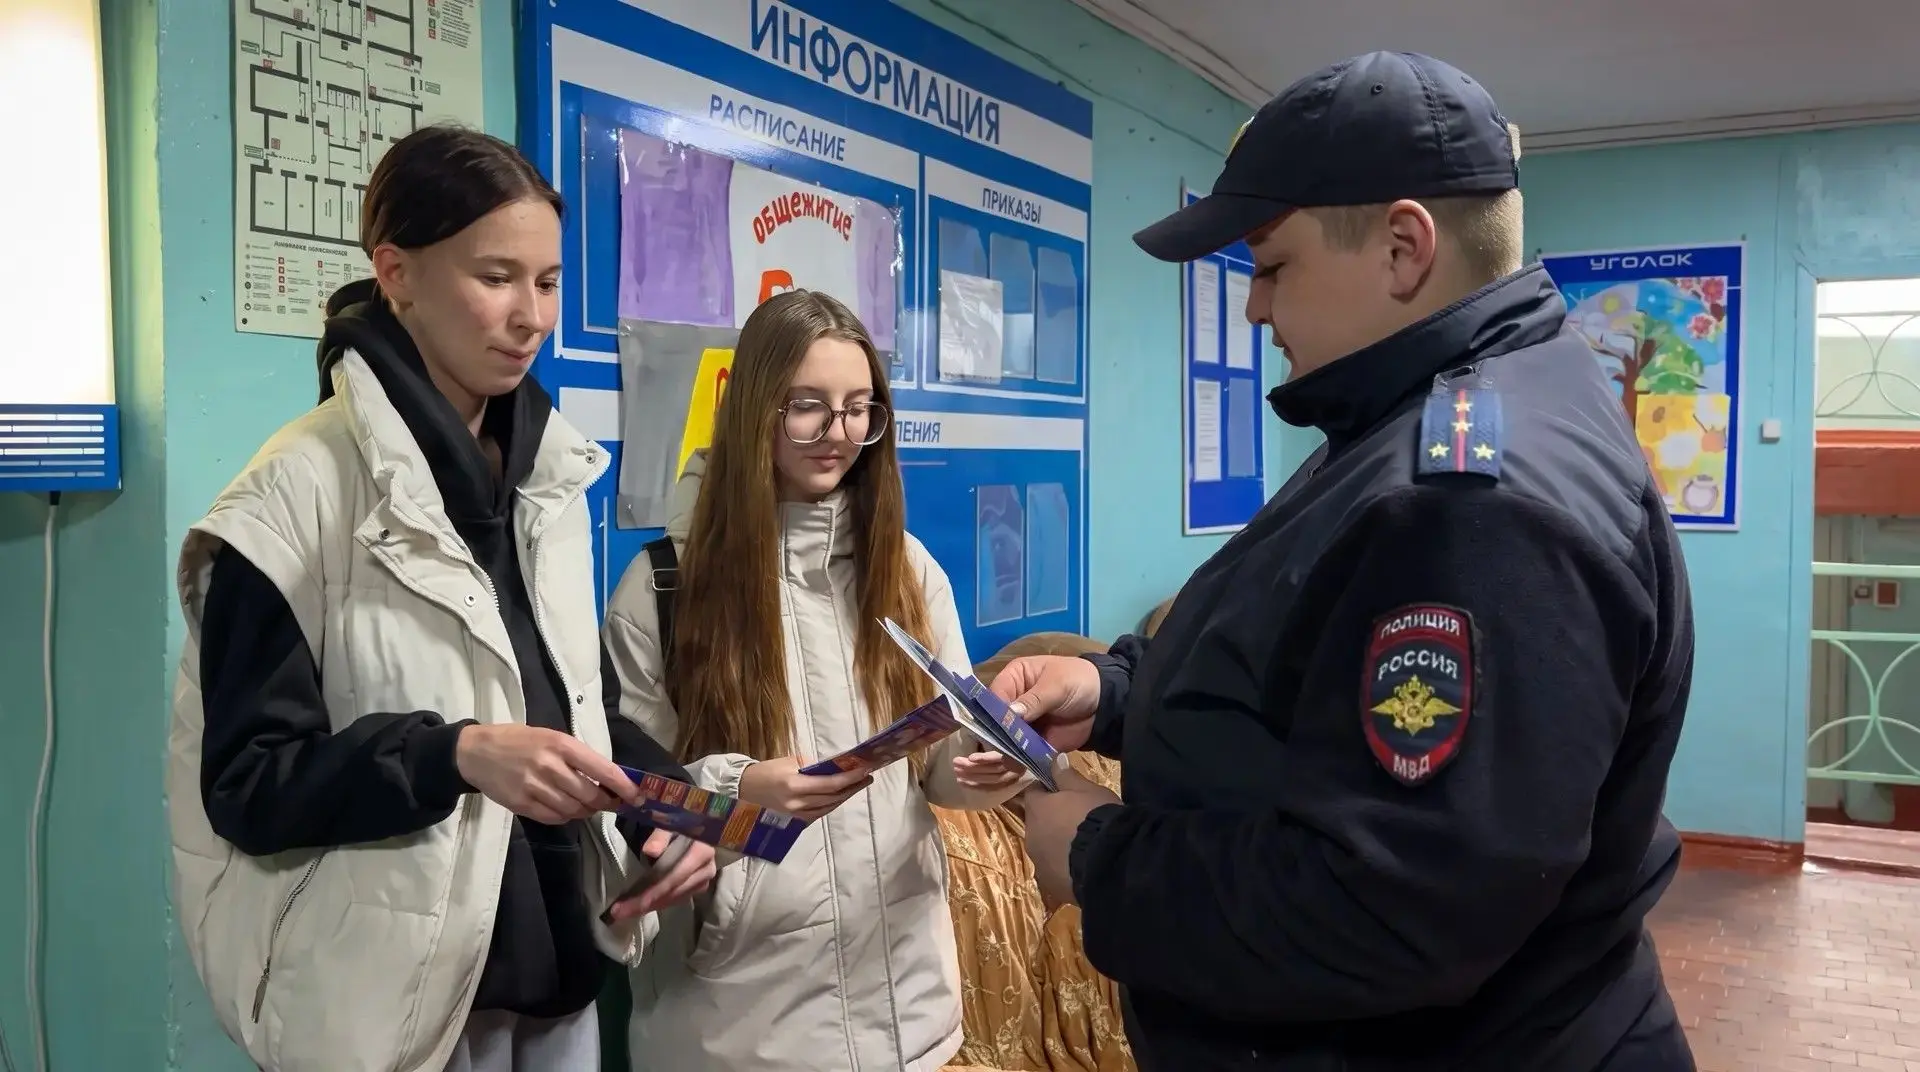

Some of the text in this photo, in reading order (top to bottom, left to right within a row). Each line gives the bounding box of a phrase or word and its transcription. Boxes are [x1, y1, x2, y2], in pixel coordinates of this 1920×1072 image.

[750, 0, 1000, 145] ИНФОРМАЦИЯ
[709, 94, 846, 161] РАСПИСАНИЕ
[982, 187, 1041, 224] ПРИКАЗЫ
[1590, 253, 1693, 270] УГОЛОК
[1381, 613, 1460, 639] ПОЛИЦИЯ
[1377, 650, 1458, 680] РОССИЯ
[1393, 754, 1431, 780] МВД
